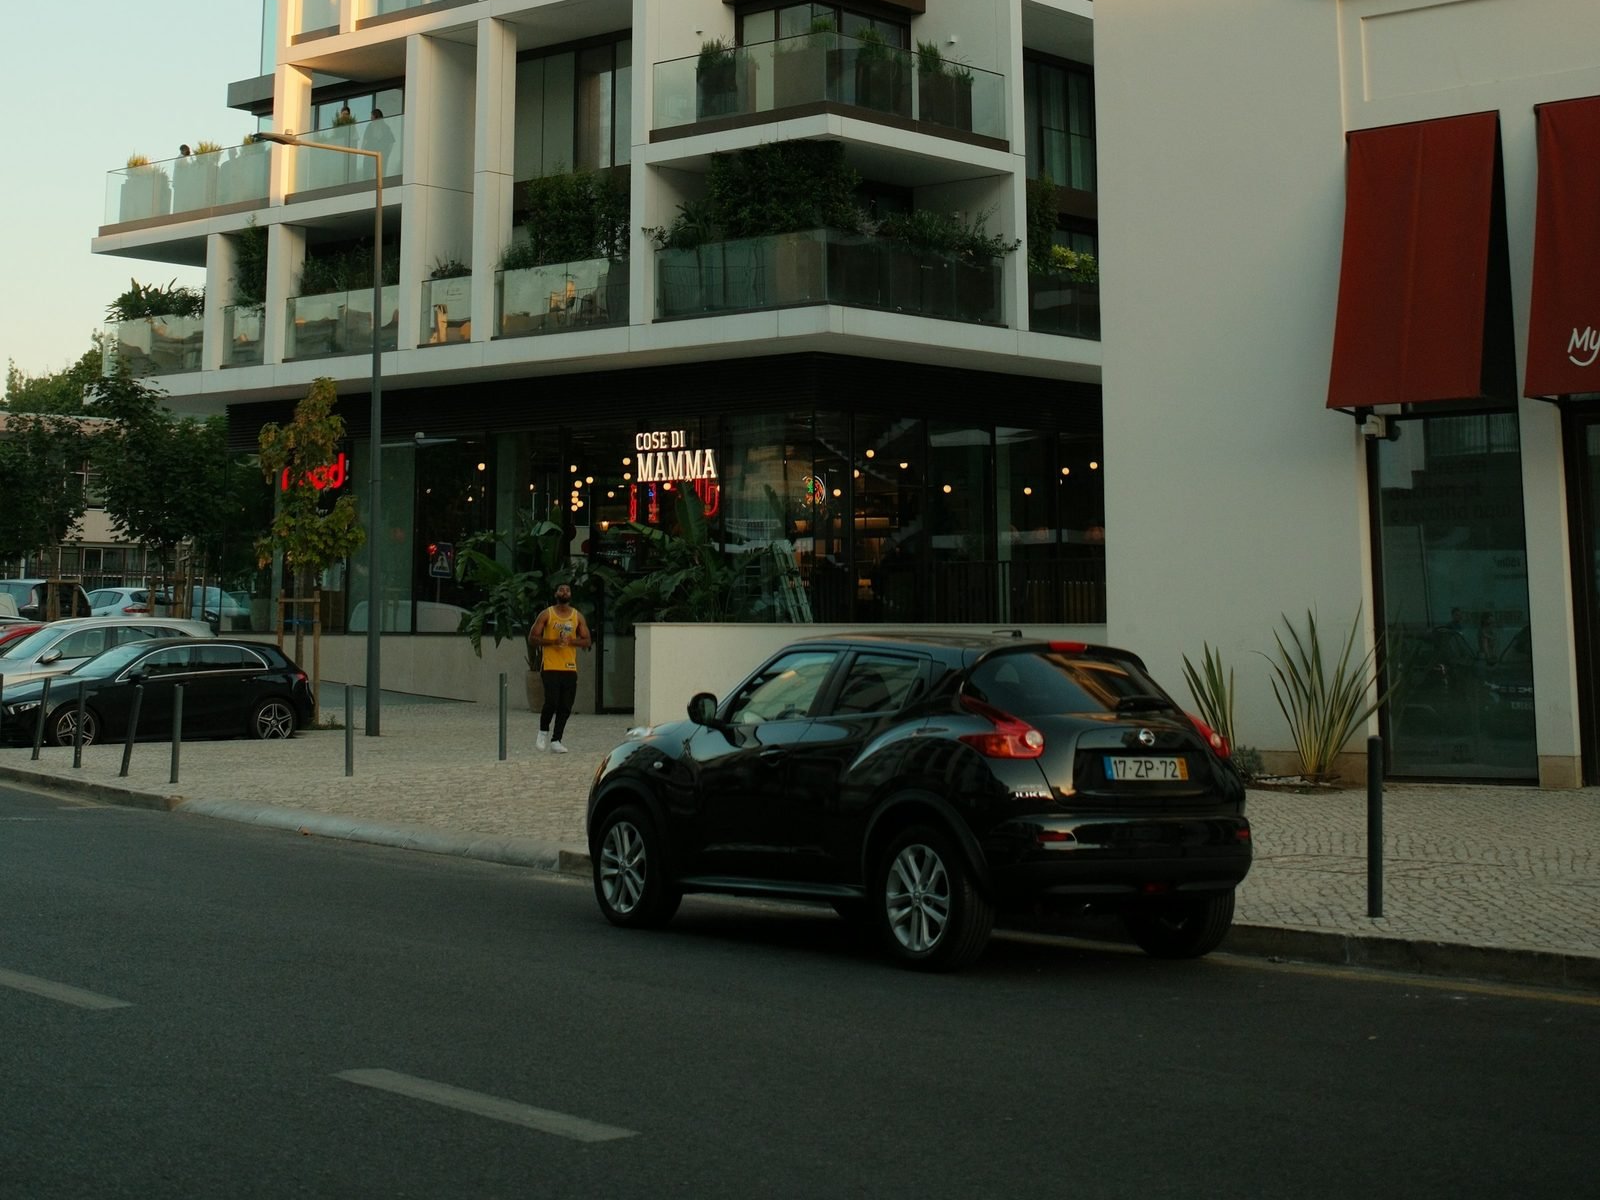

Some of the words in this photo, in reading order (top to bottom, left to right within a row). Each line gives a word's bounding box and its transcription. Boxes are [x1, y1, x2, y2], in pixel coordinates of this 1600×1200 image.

[1567, 325, 1600, 366] My
[636, 431, 668, 450] COSE
[671, 430, 687, 448] DI
[637, 448, 718, 482] MAMMA
